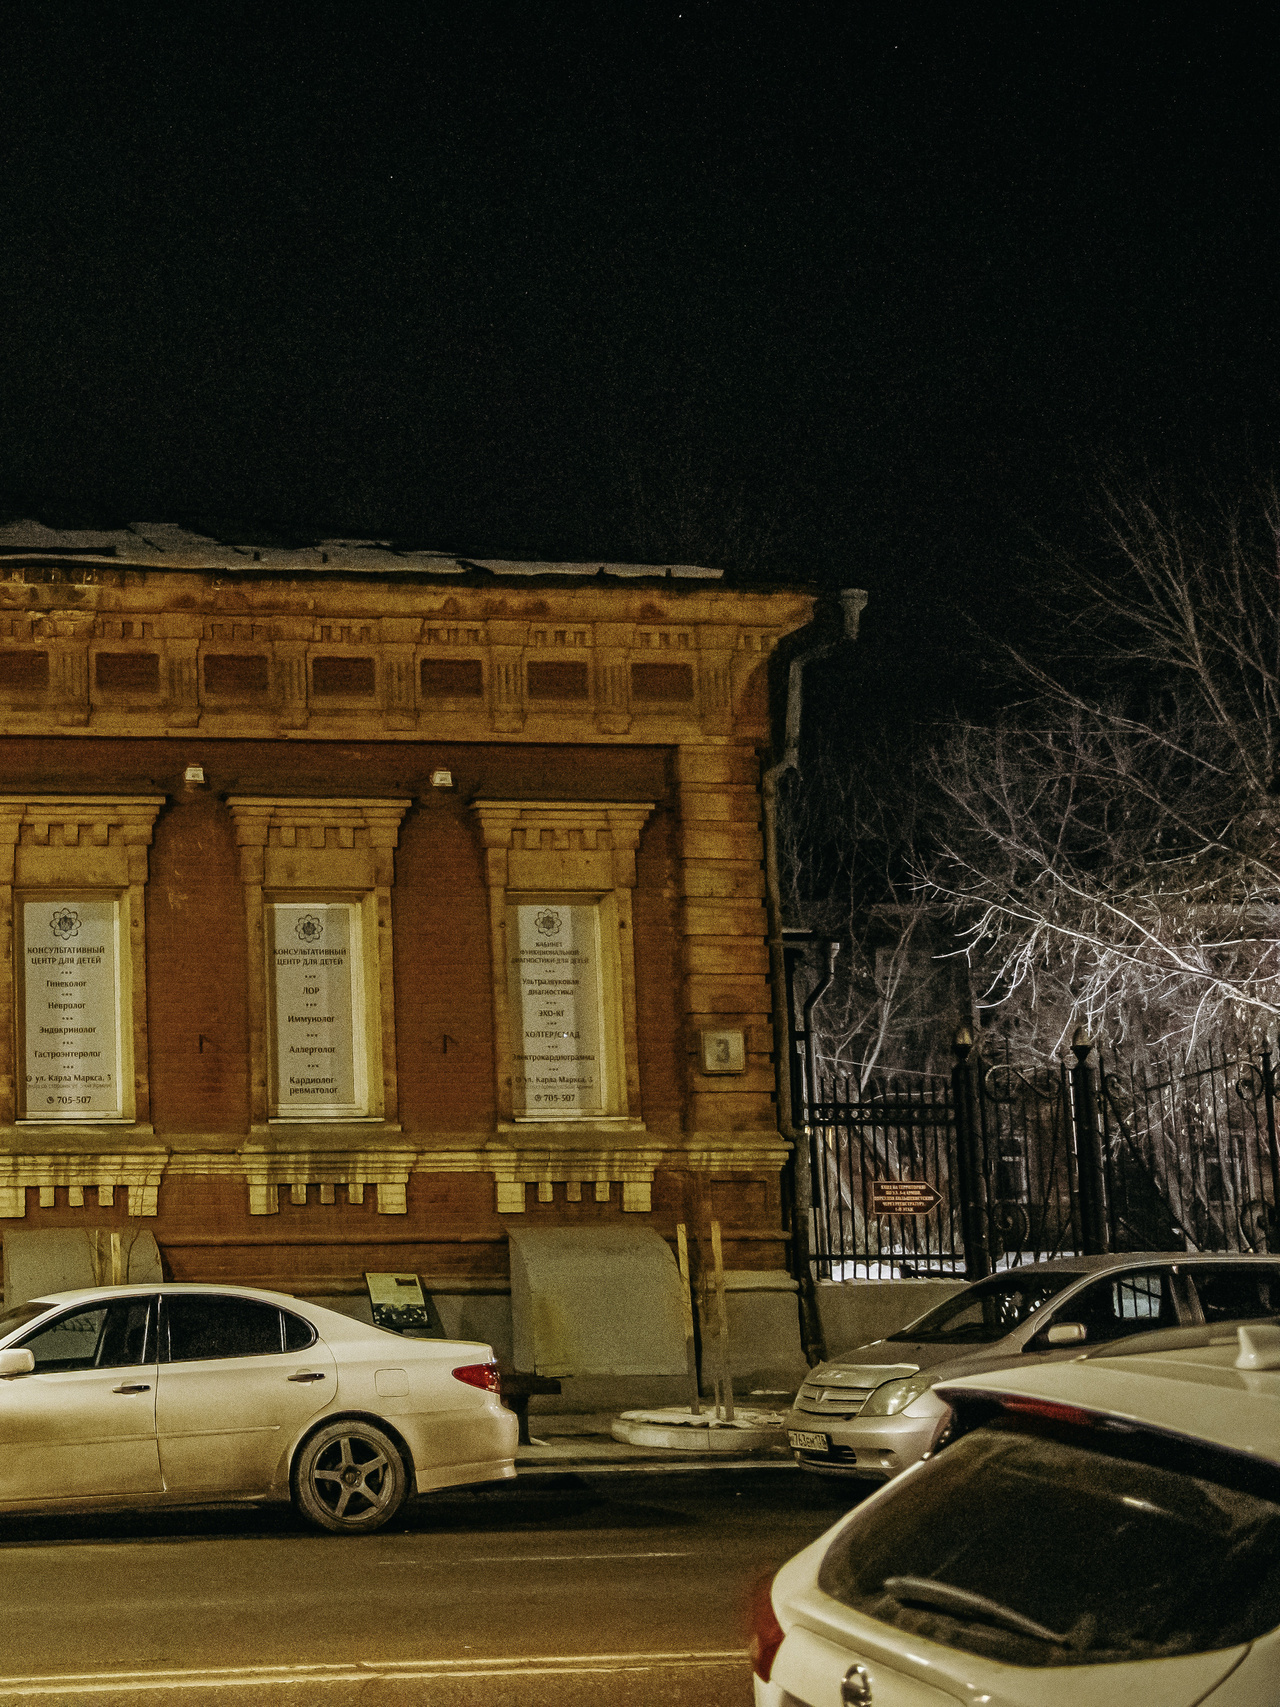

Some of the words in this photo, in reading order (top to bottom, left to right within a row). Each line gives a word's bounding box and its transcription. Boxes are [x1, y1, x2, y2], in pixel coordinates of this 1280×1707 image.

[28, 946, 105, 954] КОНСУЛЬТАТИВНЫЙ
[31, 957, 56, 965] ЦЕНТР
[58, 957, 74, 965] ДЛЯ
[77, 956, 101, 965] ДЕТЕЙ
[302, 958, 318, 966] ДЛЯ
[47, 980, 86, 988] Гинеколог
[522, 978, 579, 986] Ультразвуковая
[48, 1002, 85, 1010] Невролог
[288, 1015, 335, 1023] Иммунолог
[39, 1026, 96, 1034] Эндокринолог
[525, 1031, 580, 1039] ХОЛТЕР/СМАД
[289, 1046, 335, 1054] Аллерголог
[513, 1054, 595, 1062] Электрокардиограмма
[36, 1075, 47, 1083] ул.
[48, 1074, 72, 1083] Карла
[289, 1087, 338, 1095] ревматолог
[544, 1094, 575, 1102] 705-507
